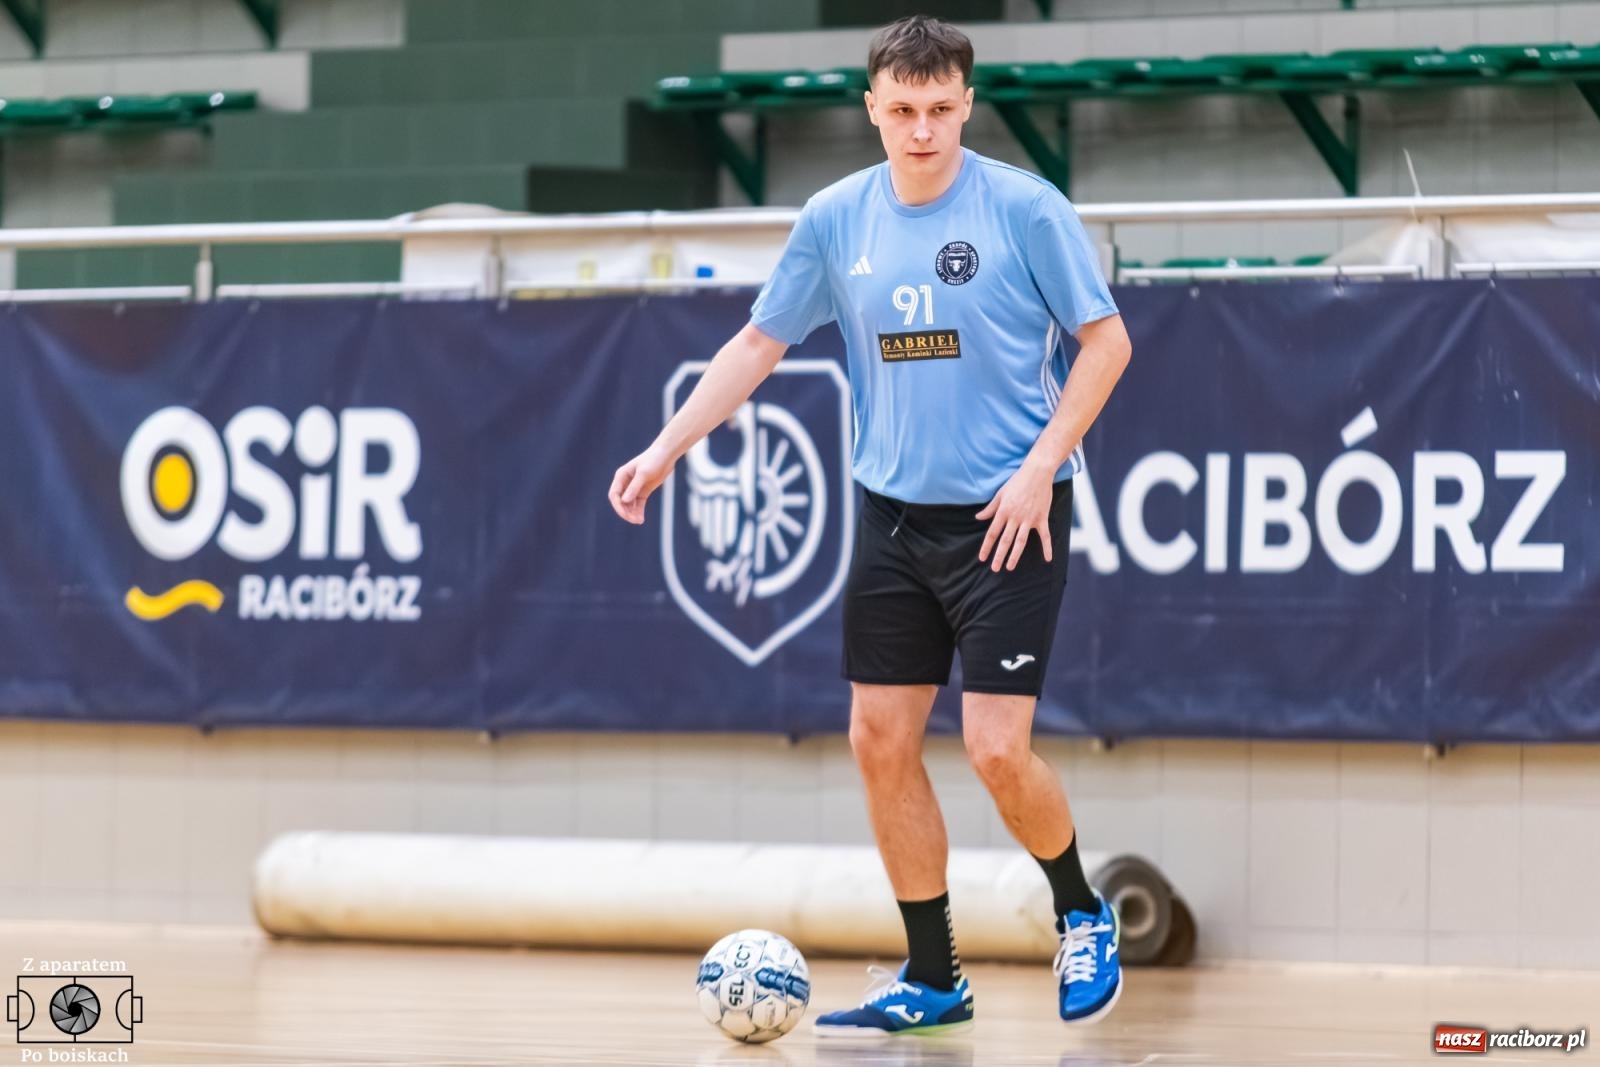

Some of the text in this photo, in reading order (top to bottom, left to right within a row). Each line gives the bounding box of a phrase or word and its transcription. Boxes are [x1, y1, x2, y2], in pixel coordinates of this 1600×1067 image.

[892, 284, 934, 326] 91
[881, 335, 958, 349] GABRIEL
[1067, 406, 1566, 574] ACIBÓRZ
[238, 563, 421, 621] RACIBÓRZ
[729, 978, 745, 1006] SEL
